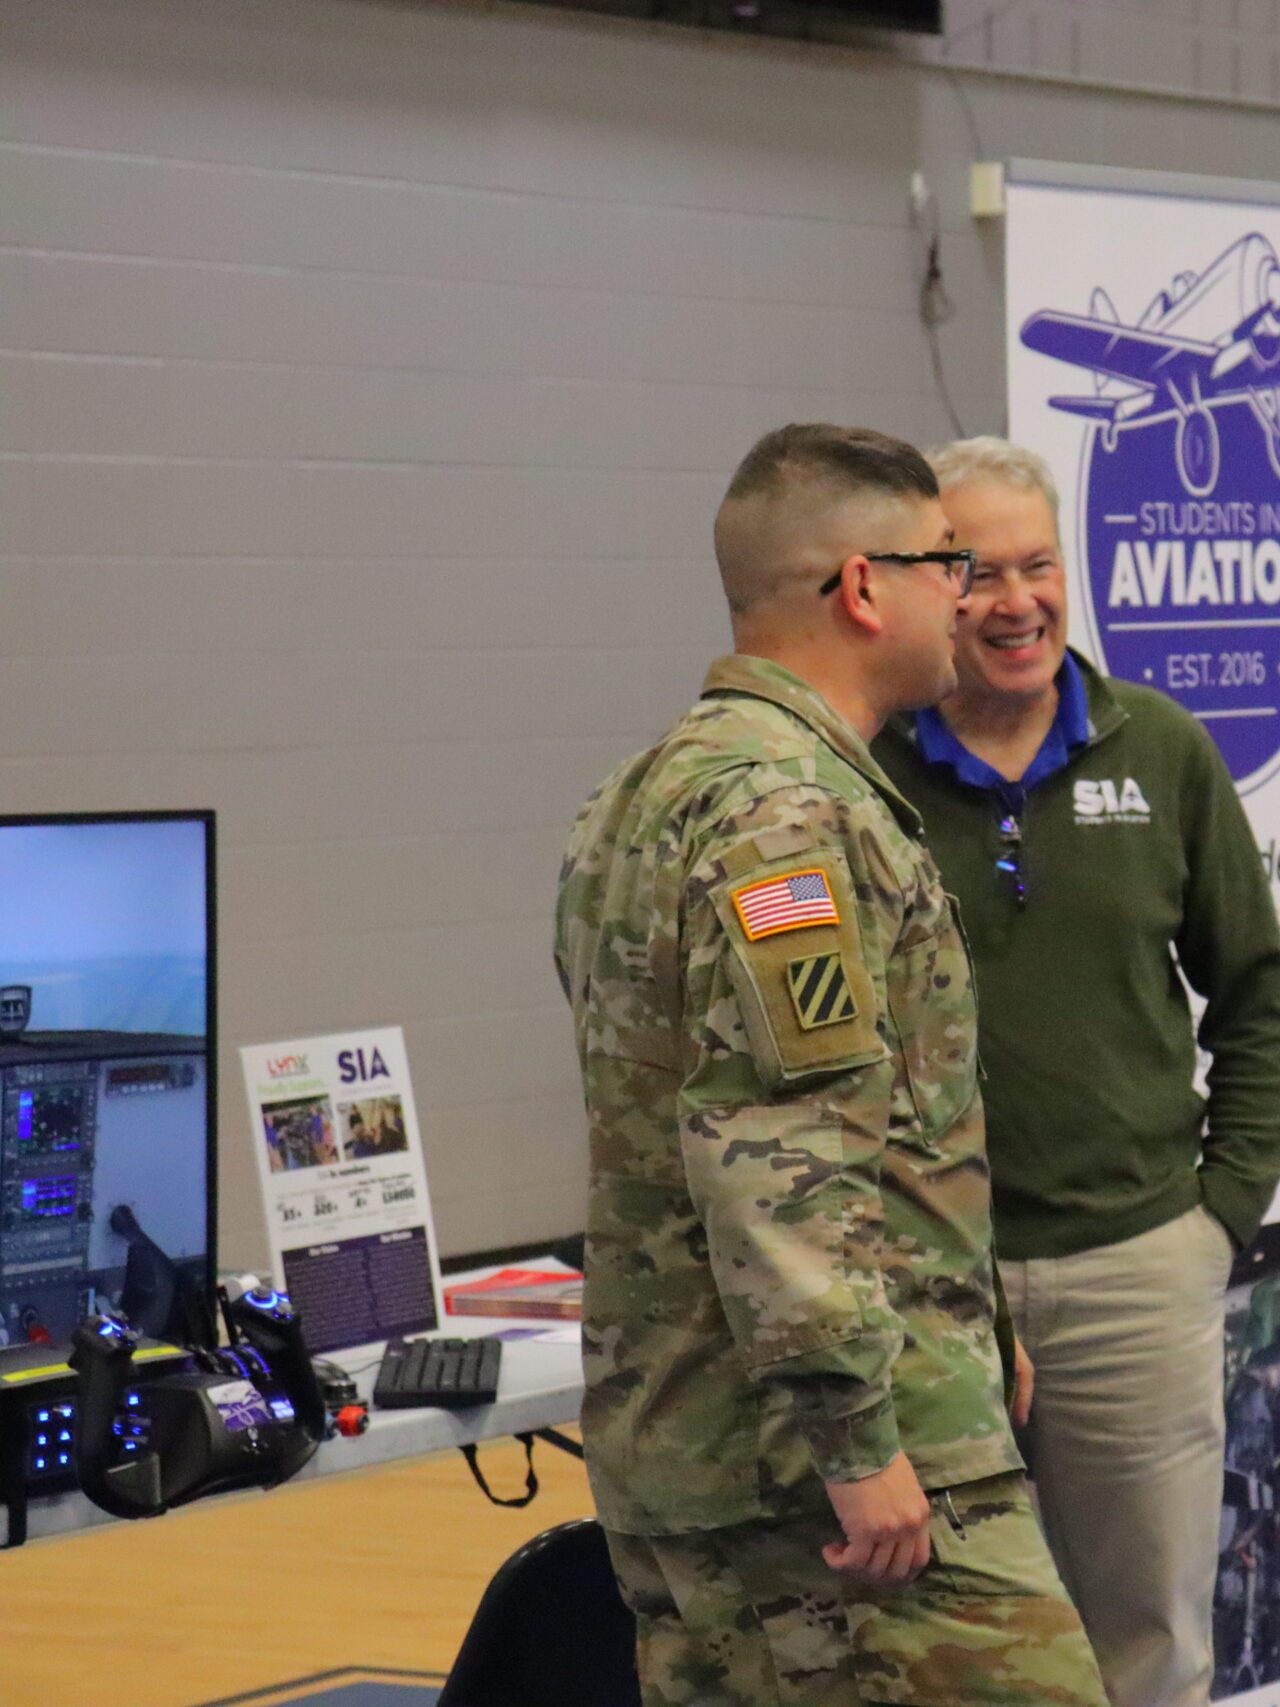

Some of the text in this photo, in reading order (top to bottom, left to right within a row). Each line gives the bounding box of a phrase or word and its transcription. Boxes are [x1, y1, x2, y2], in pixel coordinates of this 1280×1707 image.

[1141, 502, 1255, 534] STUDENTS
[1167, 651, 1266, 688] EST. 2016
[1073, 777, 1150, 816] SIA
[338, 1045, 391, 1084] SIA
